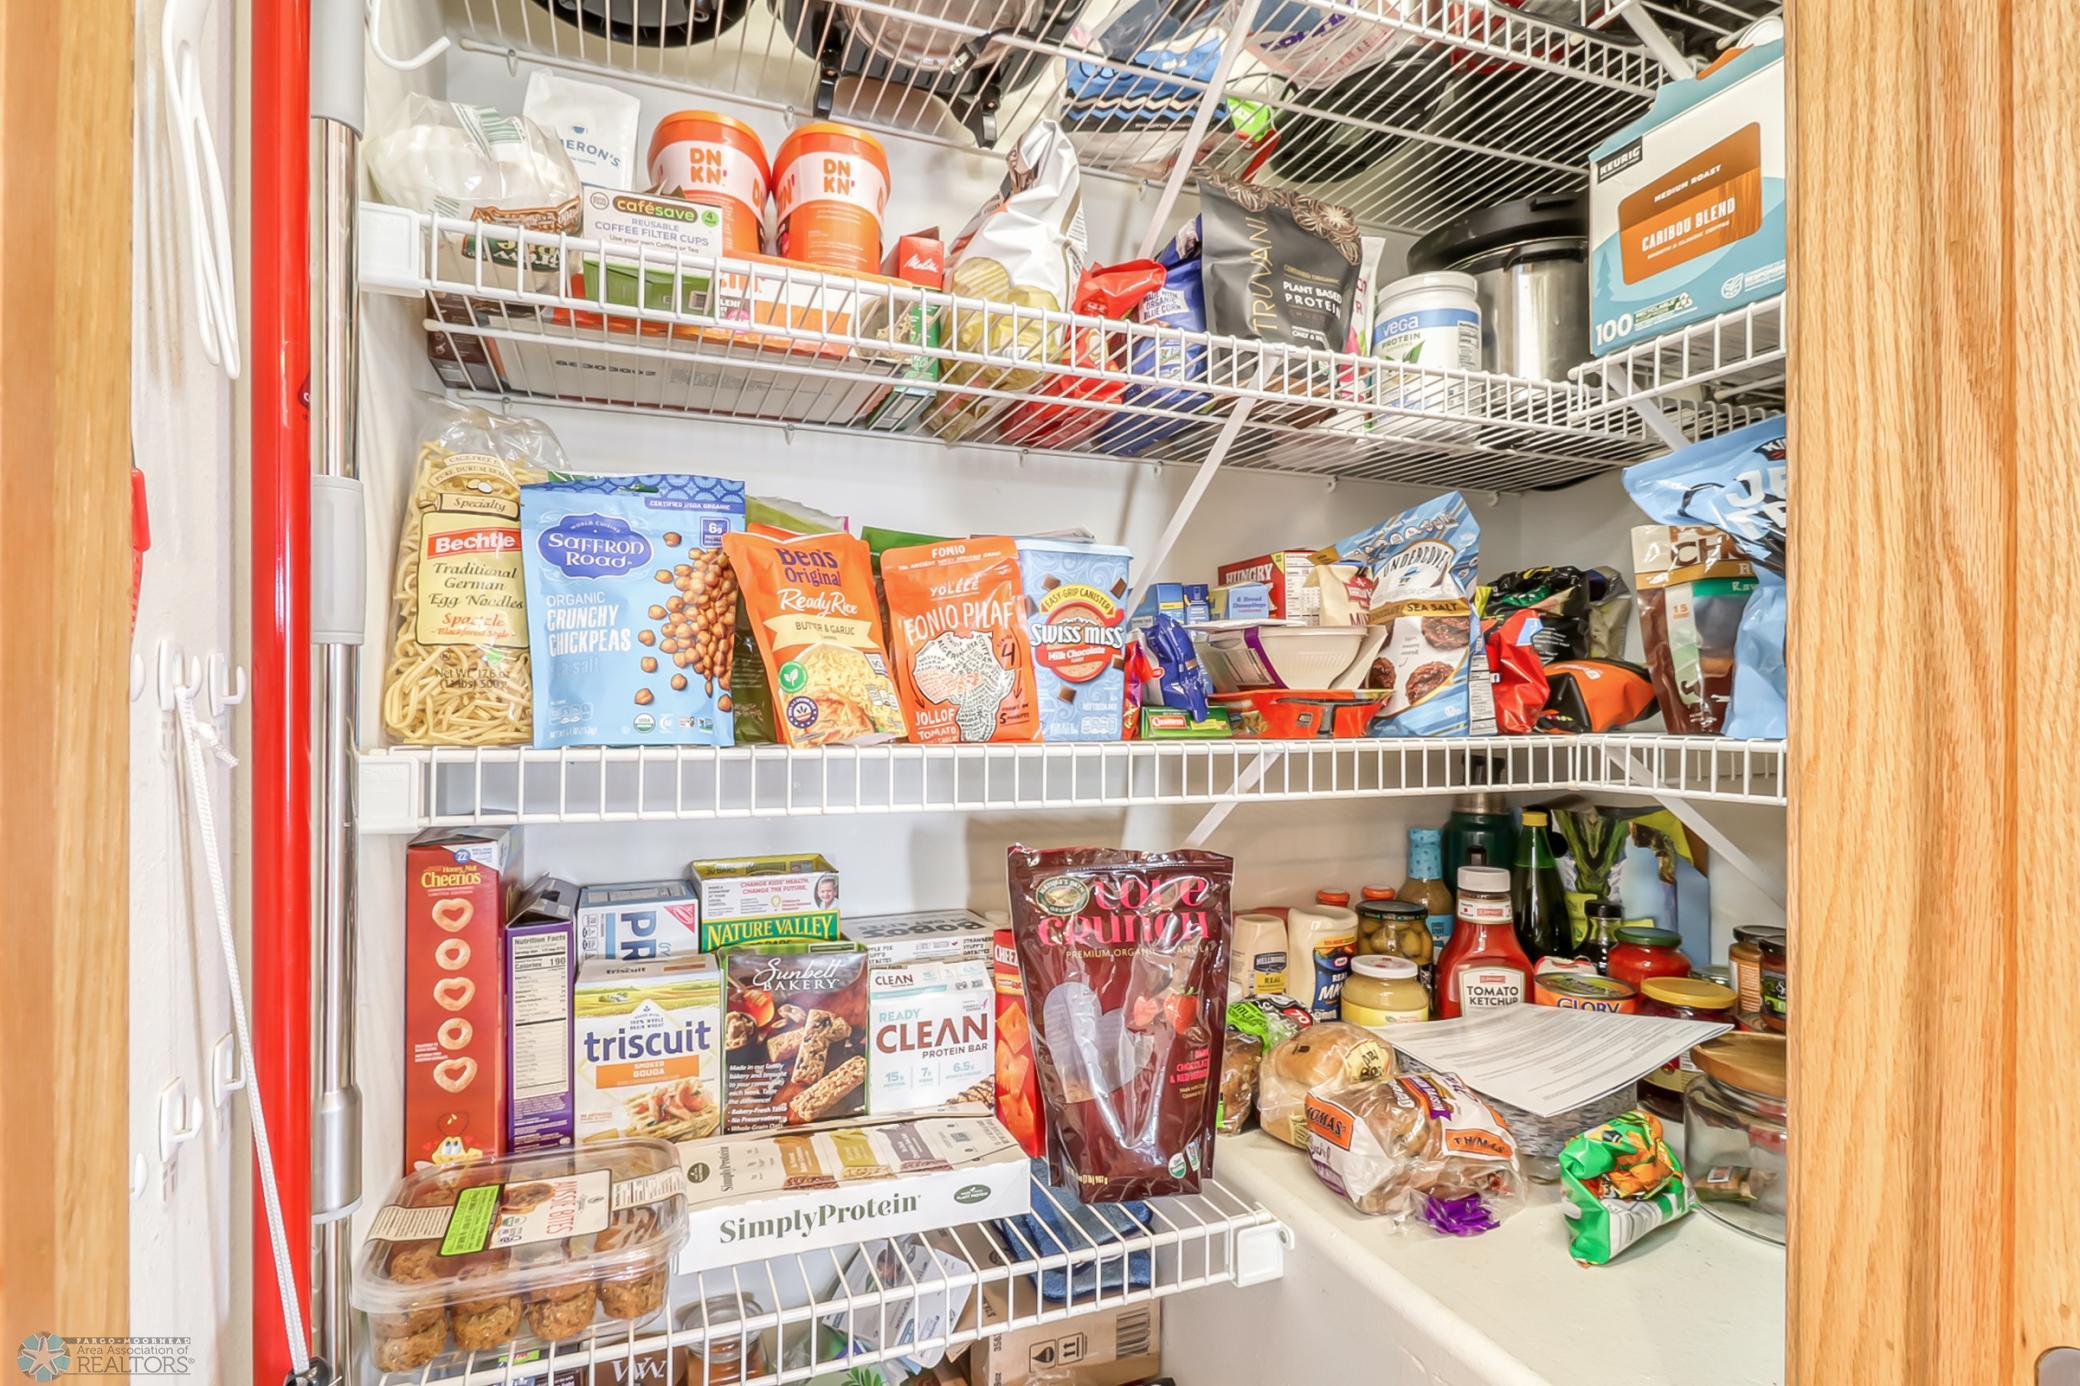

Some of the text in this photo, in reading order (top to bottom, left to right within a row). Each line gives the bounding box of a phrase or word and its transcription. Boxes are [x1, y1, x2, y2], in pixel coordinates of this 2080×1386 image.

[690, 147, 722, 166] DN
[1600, 145, 1641, 175] KEURIG
[823, 158, 850, 177] DN
[1654, 164, 1722, 203] MEDIUM ROAST
[631, 218, 680, 232] REUSABLE
[1641, 197, 1736, 252] CARIBOU BLEND
[595, 221, 710, 247] COFFEE FILTER CUPS
[1245, 215, 1278, 332] TRUVANI
[1283, 281, 1343, 304] PLANT BASED
[1285, 293, 1341, 320] PROTEIN
[1382, 316, 1419, 337] vega
[1595, 313, 1633, 346] 100
[454, 497, 507, 513] Specialty
[708, 522, 723, 535] 6g
[435, 531, 516, 554] Bechtle
[931, 544, 966, 559] FONIO
[566, 551, 627, 568] Road
[776, 548, 839, 569] Ben's
[1382, 545, 1449, 579] UNDERCOVE
[432, 562, 518, 579] Traditional
[785, 567, 842, 587] Original
[1225, 563, 1273, 585] HUNGRY
[444, 577, 505, 591] German
[428, 593, 524, 609] Egg Noodles
[546, 591, 606, 607] ORGANIC
[1080, 588, 1111, 610] CANISTER
[1406, 602, 1459, 612] SEA SALT
[1673, 603, 1688, 613] 15
[547, 604, 620, 632] CRUNCHY
[903, 599, 1014, 646] FONIO PILAF
[830, 624, 856, 636] GARLIC
[548, 627, 633, 657] CHICKPEAS
[1001, 641, 1016, 667] 4
[1048, 646, 1106, 661] Milk Chocolate
[915, 708, 955, 727] JOLLOF
[999, 712, 1007, 725] 5
[917, 727, 957, 741] TOMATO
[457, 851, 470, 861] 22
[464, 865, 477, 873] Nut
[421, 870, 482, 888] Cheerios
[740, 880, 767, 888] CHANGE
[515, 934, 566, 945] Nutrition Facts
[707, 915, 833, 952] NATURE VALLEY
[1066, 947, 1154, 959] PREMIUM ORGANI
[515, 957, 566, 970] Calories 190
[753, 957, 844, 987] Sunbelt
[763, 977, 838, 991] BAKERY
[875, 974, 914, 986] CLEAN
[1466, 985, 1519, 996] TOMATO
[1469, 996, 1519, 1006] KETCHUP
[1557, 997, 1621, 1014] GLORY
[879, 1008, 921, 1023] READY
[584, 1020, 712, 1063] triscuit
[876, 1013, 988, 1054] CLEAN
[922, 1042, 988, 1060] PROTEIN BAR
[633, 1068, 665, 1078] GOUDA
[719, 1193, 917, 1245] SimplyProtein
